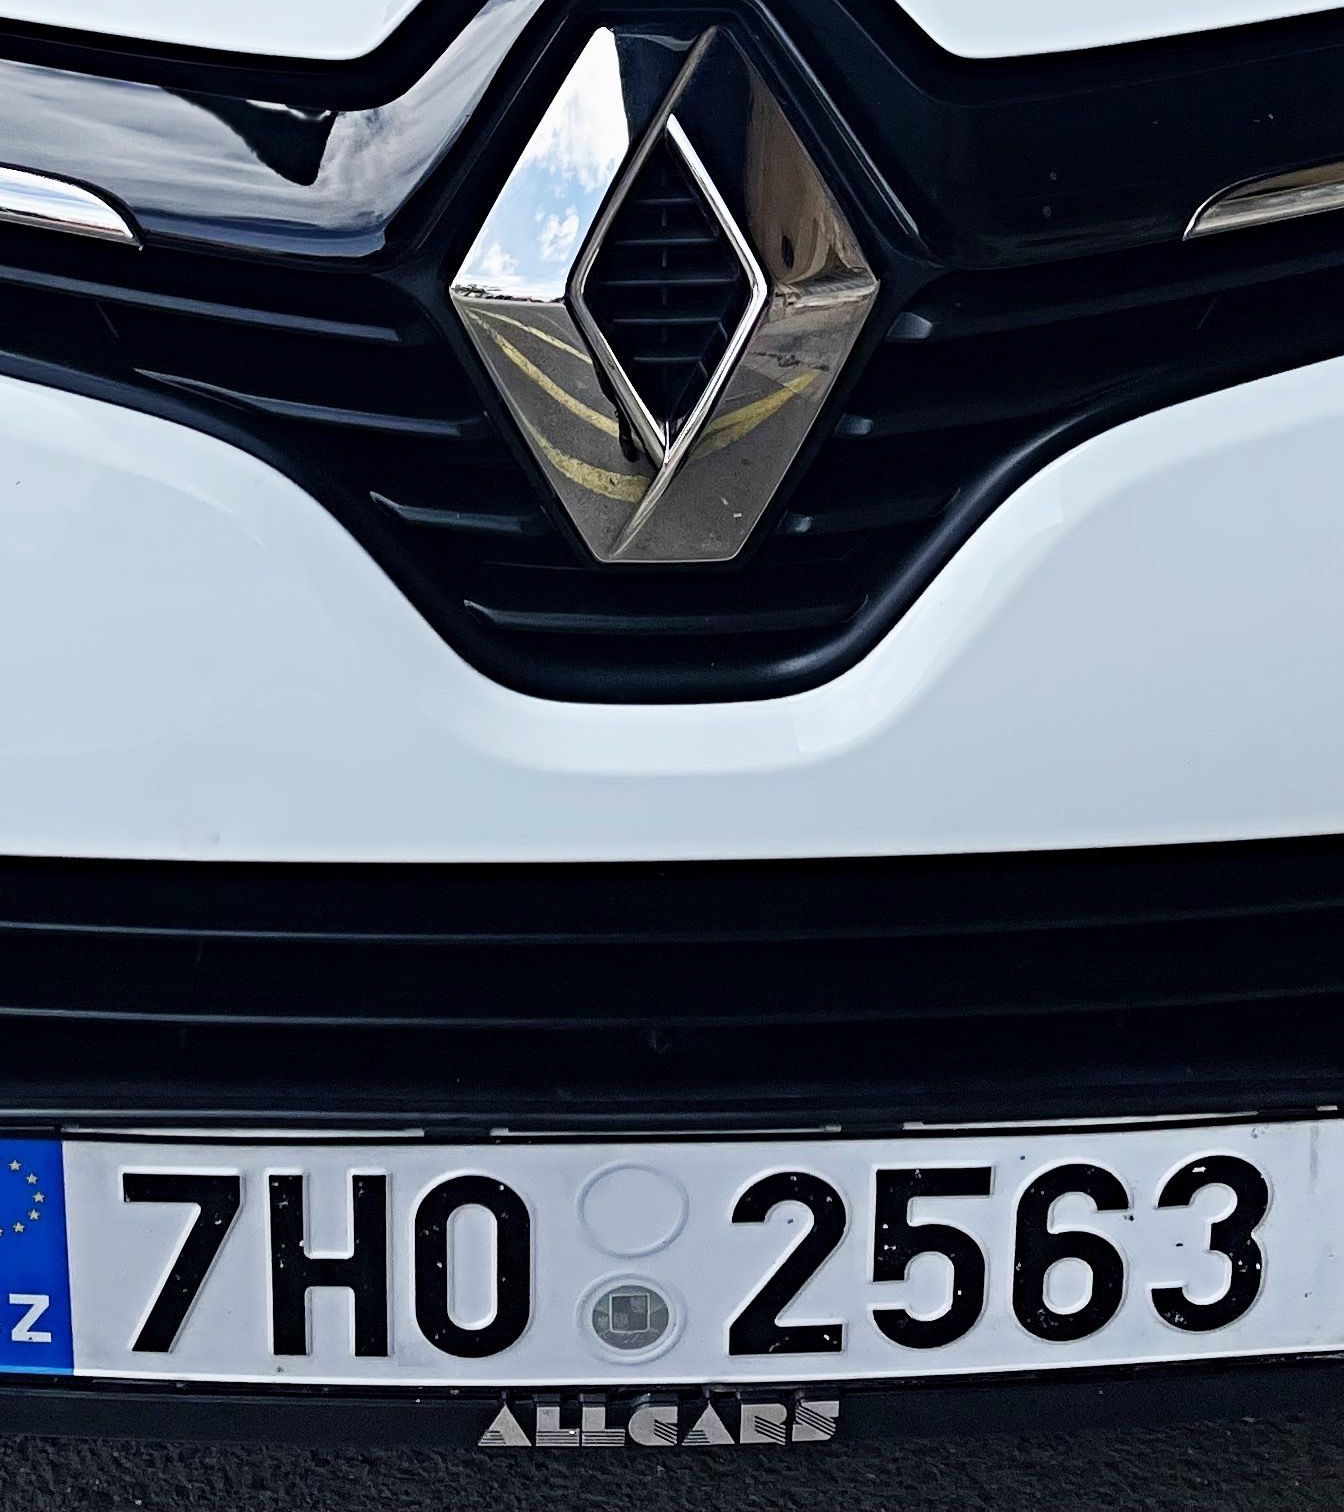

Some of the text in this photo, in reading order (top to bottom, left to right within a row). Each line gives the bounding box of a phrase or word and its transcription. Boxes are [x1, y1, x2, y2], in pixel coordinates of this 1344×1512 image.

[120, 1154, 1269, 1359] 7H0 2563
[478, 1400, 840, 1446] ALLCARS
